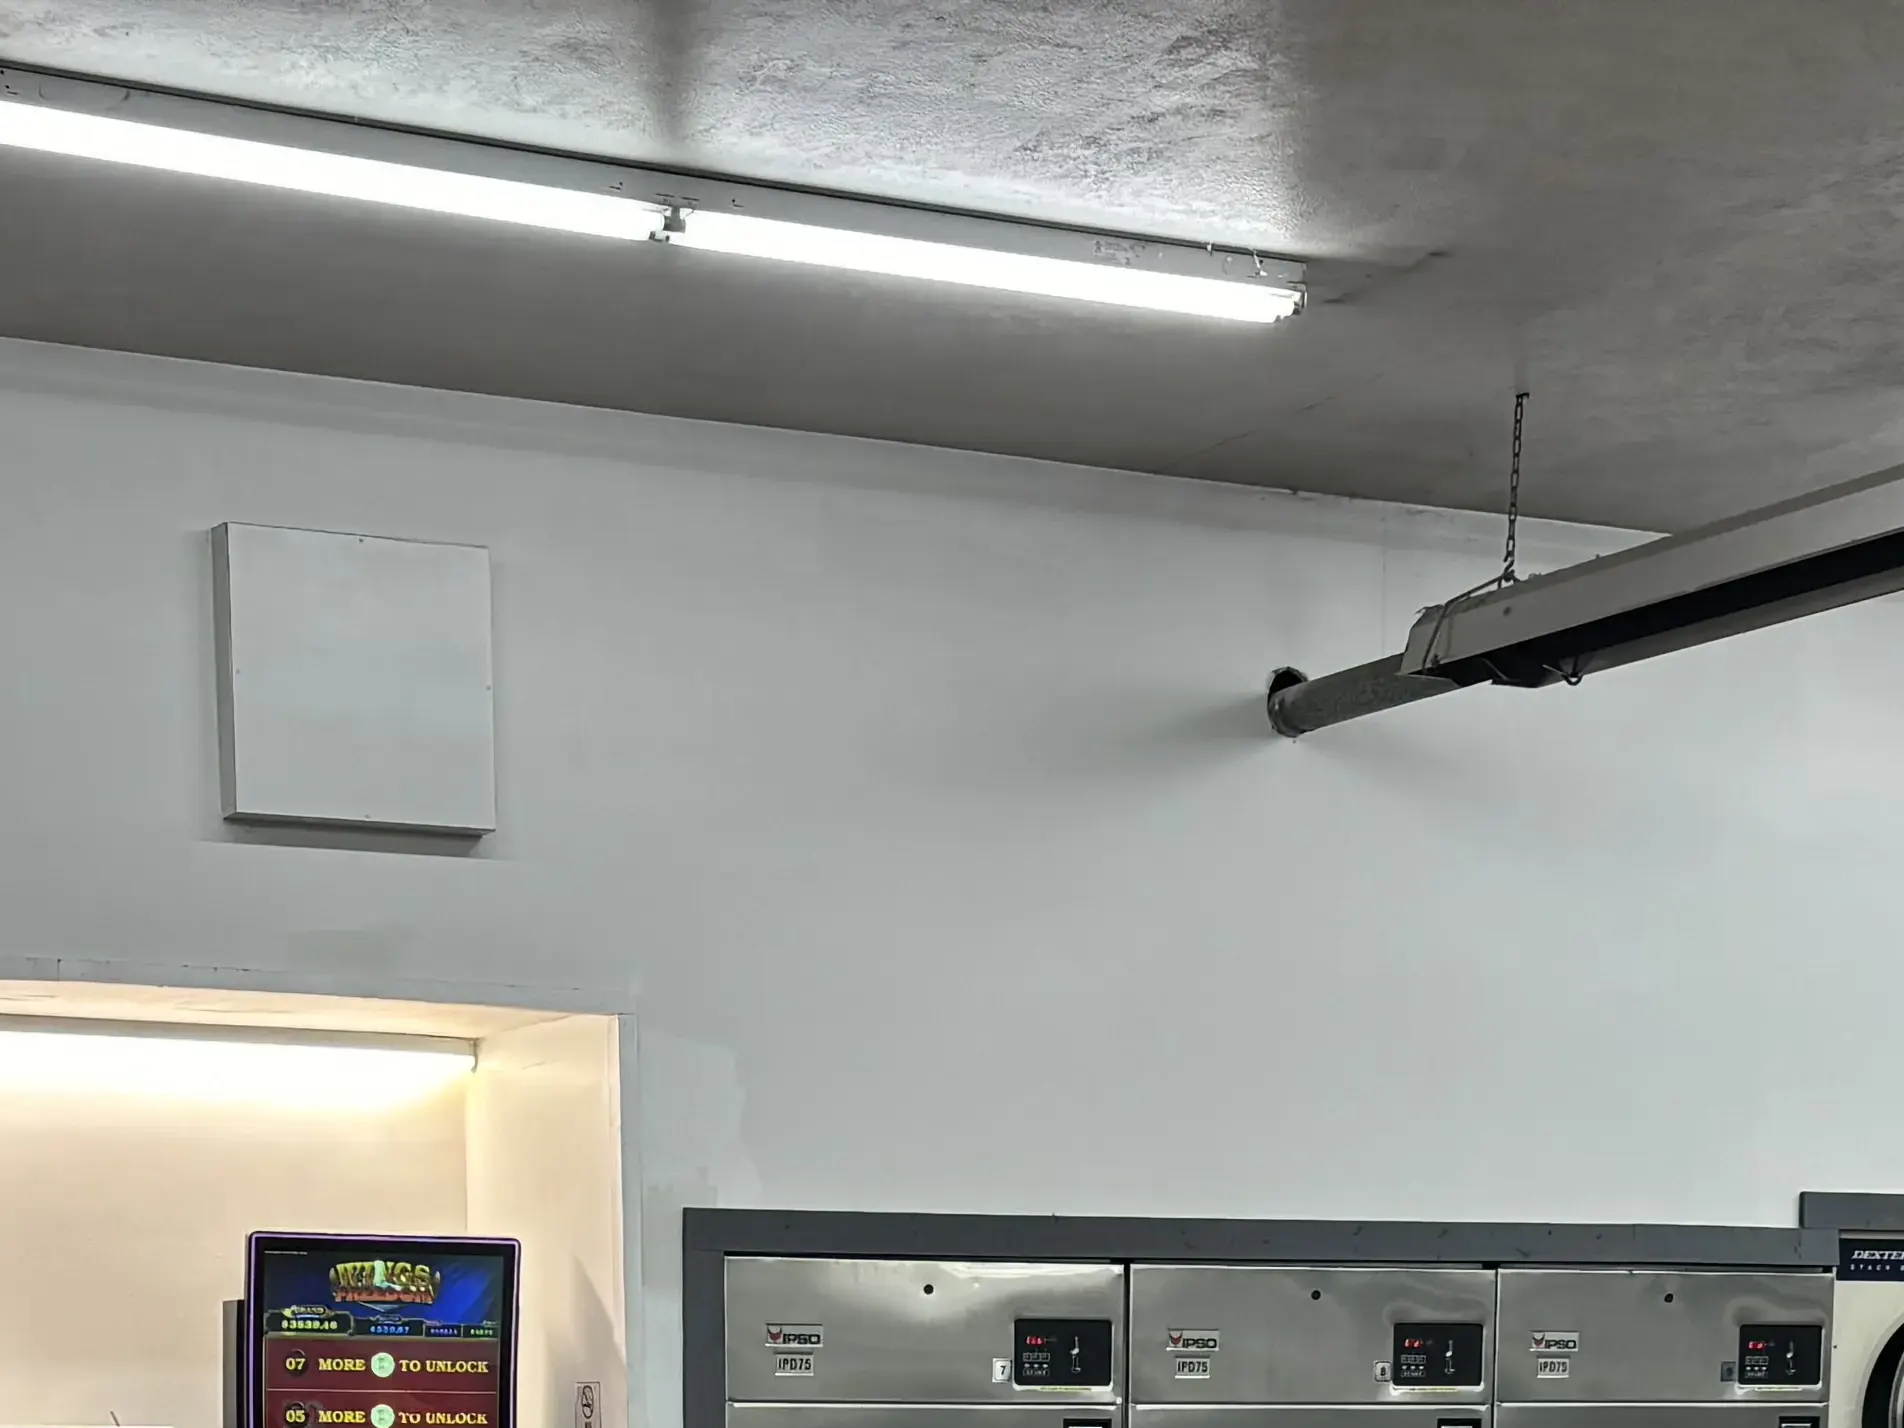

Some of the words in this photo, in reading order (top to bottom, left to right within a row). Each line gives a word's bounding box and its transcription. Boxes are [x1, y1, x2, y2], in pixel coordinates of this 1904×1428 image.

[1182, 1338, 1217, 1348] IPSO
[285, 1358, 306, 1370] 07
[318, 1358, 366, 1371] MORE
[399, 1359, 421, 1373] TO
[425, 1359, 489, 1373] UNLOCK
[778, 1358, 812, 1370] IPD75
[1000, 1365, 1006, 1375] 7
[1177, 1361, 1208, 1373] IPD75
[286, 1410, 306, 1423] 05
[318, 1410, 366, 1424] MORE
[398, 1411, 421, 1424] TO
[425, 1411, 488, 1425] UNLOCK
